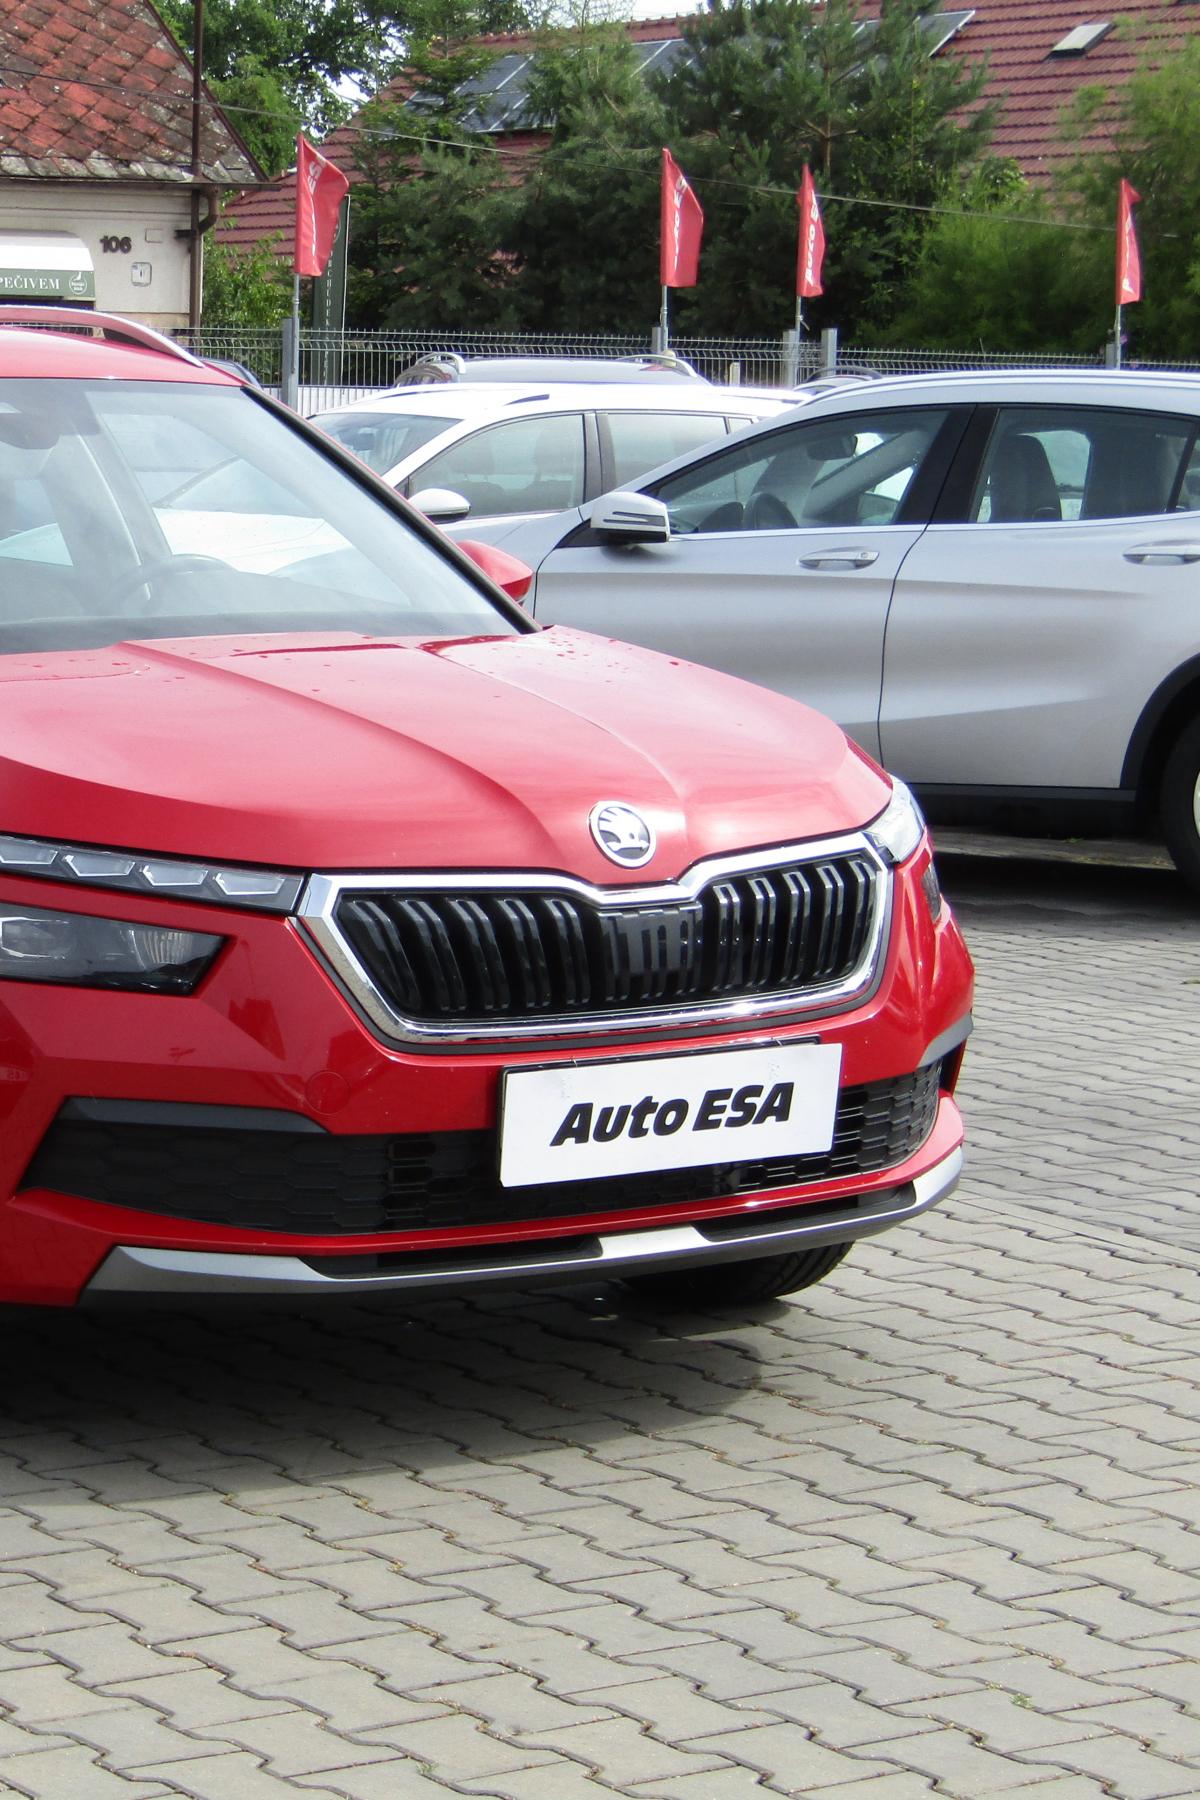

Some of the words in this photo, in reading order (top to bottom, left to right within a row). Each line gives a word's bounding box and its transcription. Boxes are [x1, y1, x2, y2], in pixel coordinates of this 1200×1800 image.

[99, 235, 132, 254] 106
[550, 1096, 689, 1147] Auto
[692, 1082, 795, 1131] ESA
